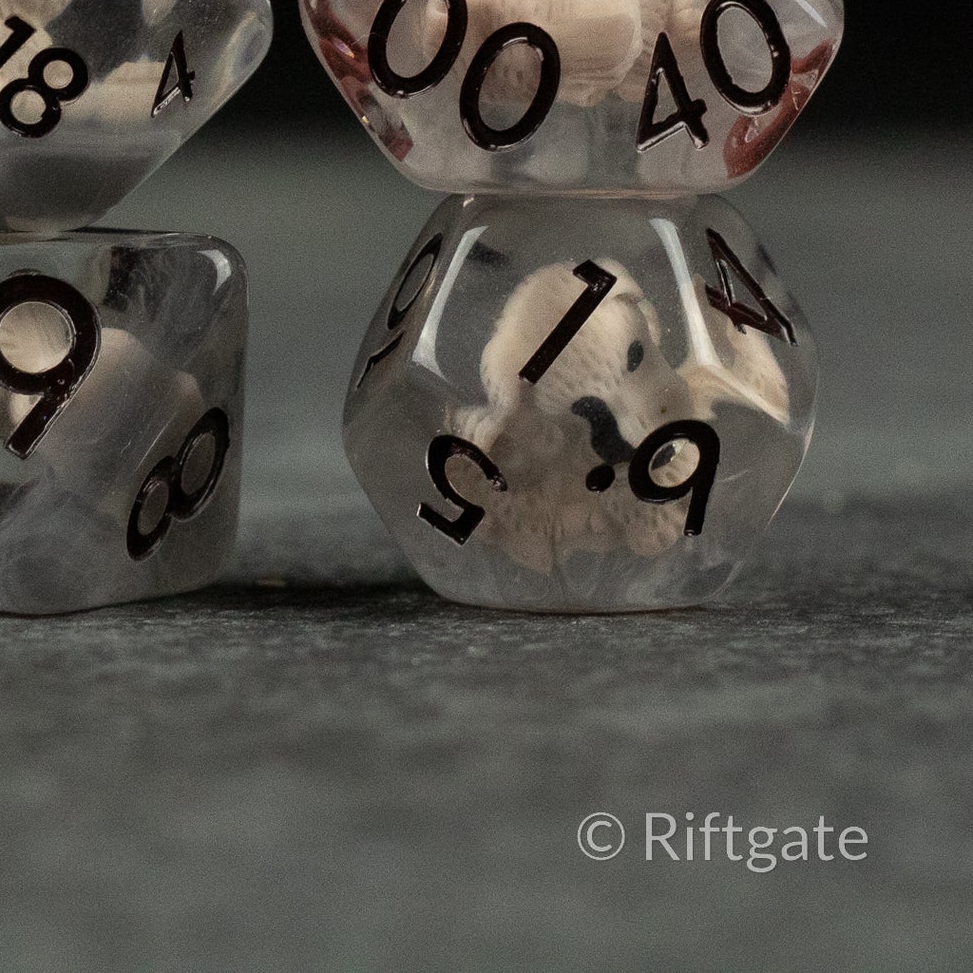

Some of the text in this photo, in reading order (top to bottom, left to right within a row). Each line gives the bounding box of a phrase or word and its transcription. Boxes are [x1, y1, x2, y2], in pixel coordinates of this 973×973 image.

[518, 259, 617, 384] 1
[705, 228, 799, 347] 4
[126, 406, 231, 563] 8
[418, 434, 508, 546] 5
